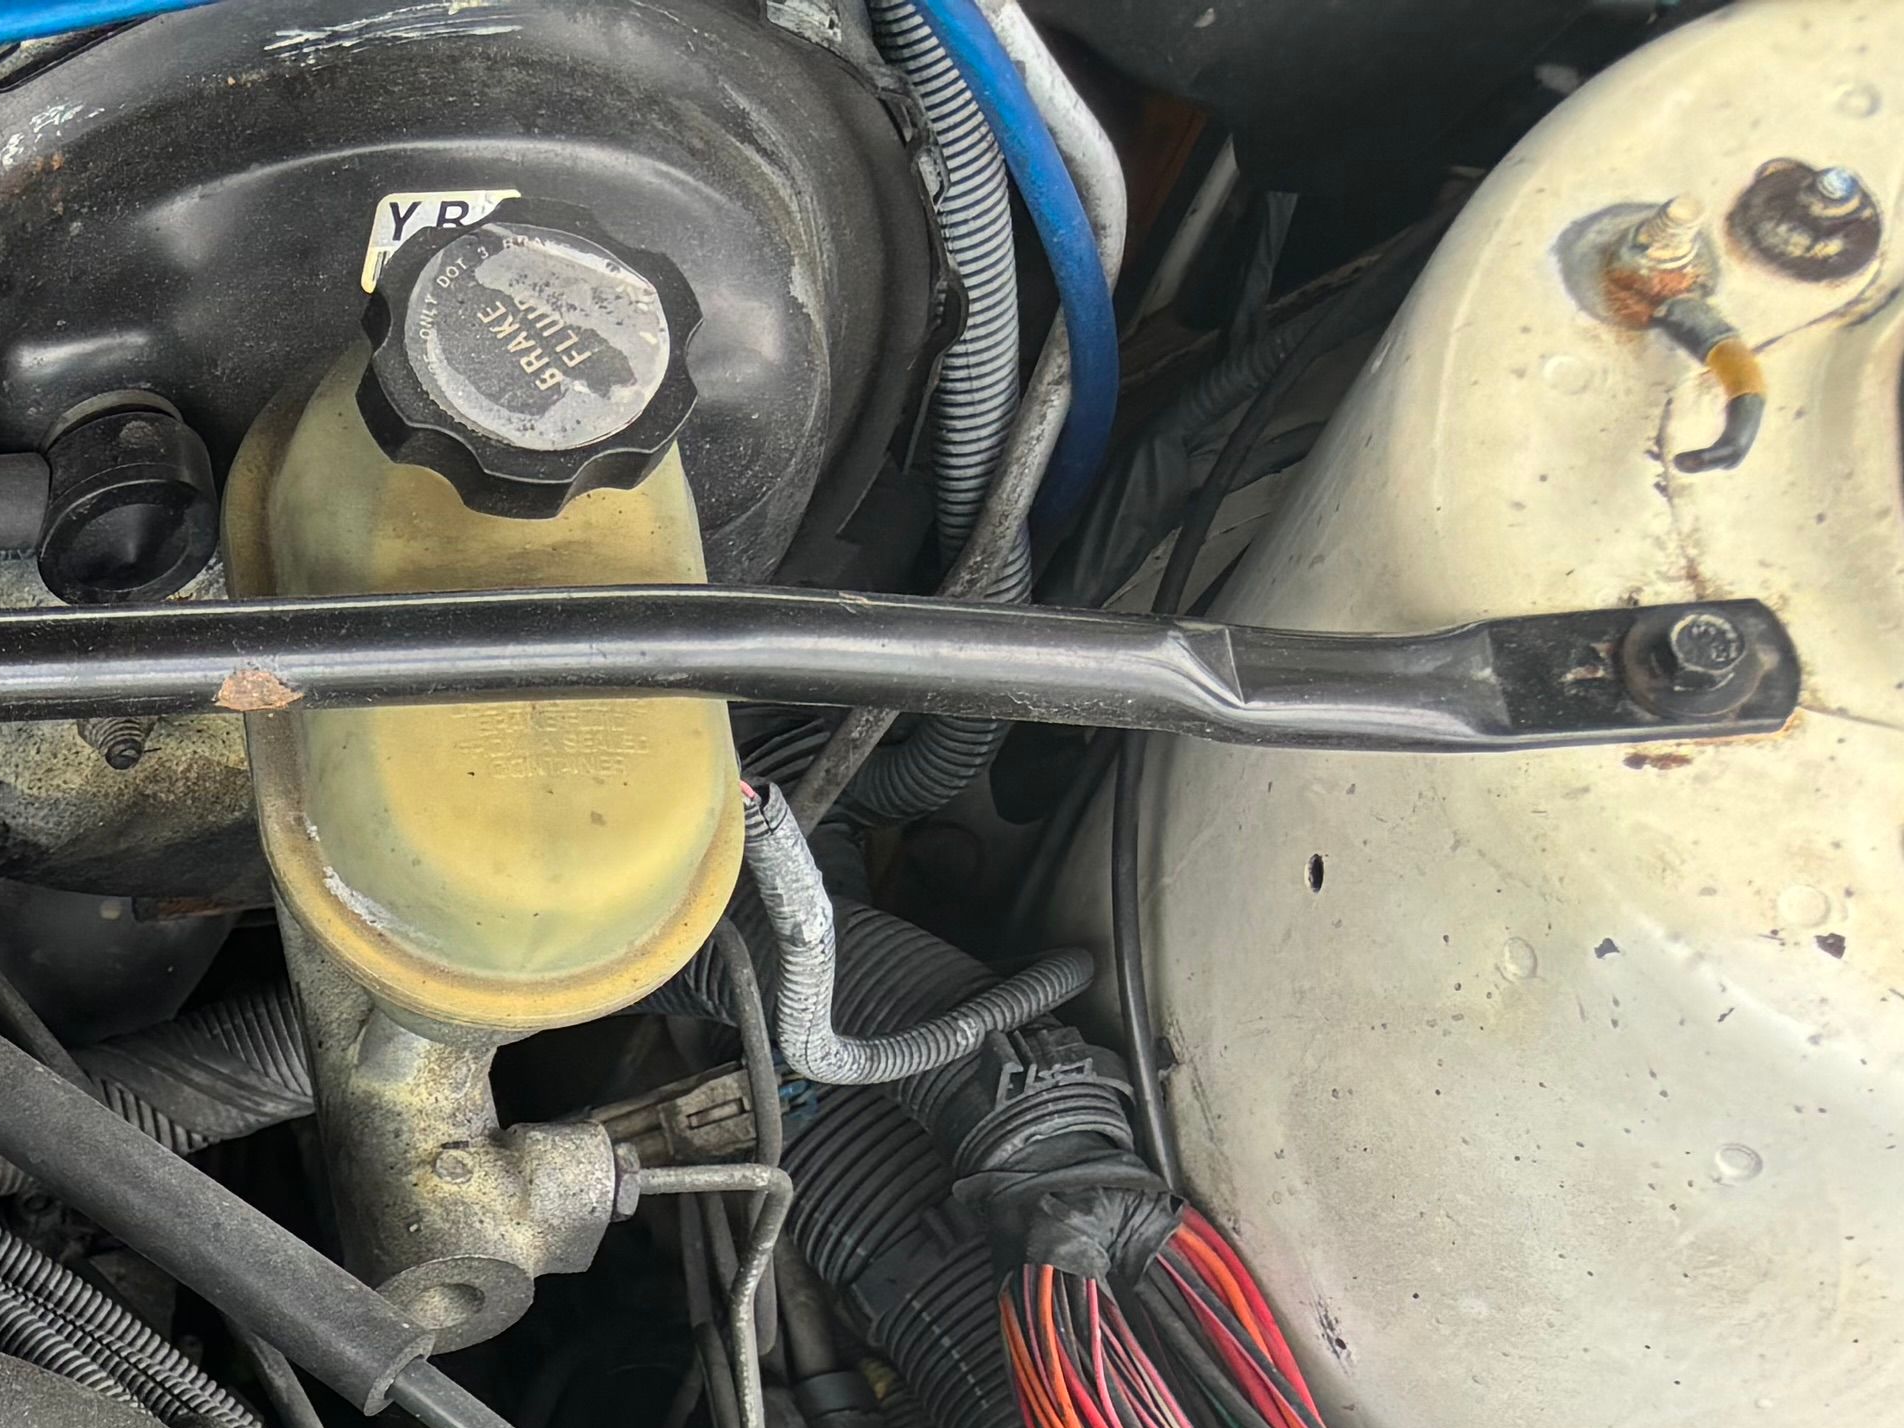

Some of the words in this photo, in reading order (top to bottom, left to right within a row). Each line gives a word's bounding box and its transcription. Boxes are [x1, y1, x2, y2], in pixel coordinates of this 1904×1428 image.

[436, 258, 468, 289] DOT
[476, 247, 490, 261] 3
[477, 300, 564, 392] BRAKE
